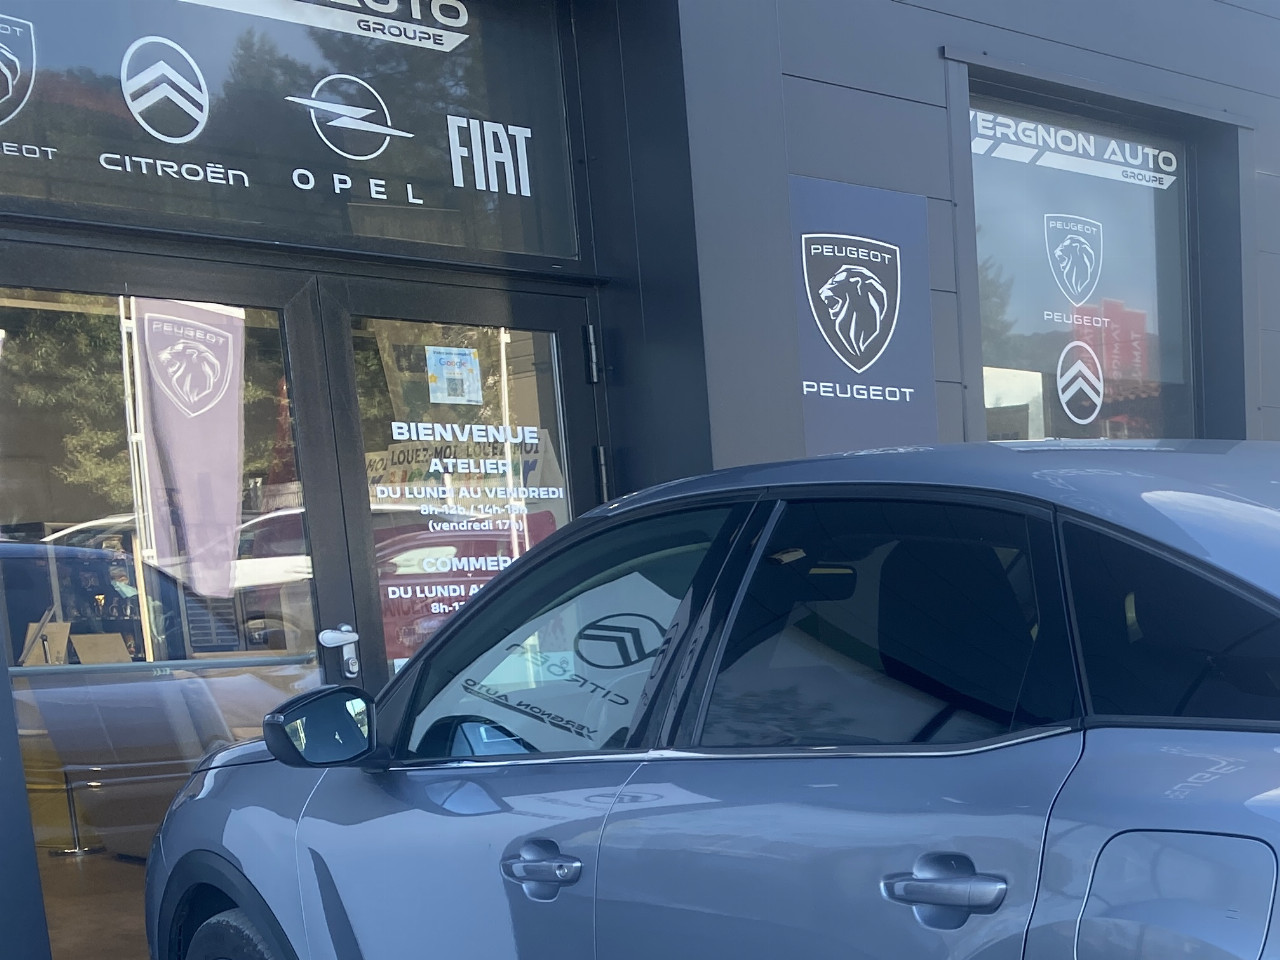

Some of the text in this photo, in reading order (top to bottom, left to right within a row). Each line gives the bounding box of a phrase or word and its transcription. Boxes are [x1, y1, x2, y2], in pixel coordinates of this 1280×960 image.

[357, 19, 445, 46] GROUPE
[447, 115, 532, 196] FIAT
[1103, 140, 1177, 172] AUTO
[292, 169, 423, 204] OPEL
[1121, 170, 1164, 186] GROUPE
[1049, 221, 1097, 235] PEUGEOT
[811, 245, 891, 264] PEUGEOT
[1044, 311, 1111, 327] PEUGEOT
[152, 321, 225, 346] PEUGEOT
[439, 358, 467, 368] Google
[803, 381, 914, 401] PEUGEOT
[391, 421, 539, 444] BIENVENUE
[429, 458, 509, 474] ATELIER
[377, 487, 564, 499] DU LUNDI AU VENDREDI
[428, 519, 493, 532] (vendredi
[388, 586, 412, 599] DU
[416, 585, 465, 598] LUNDI
